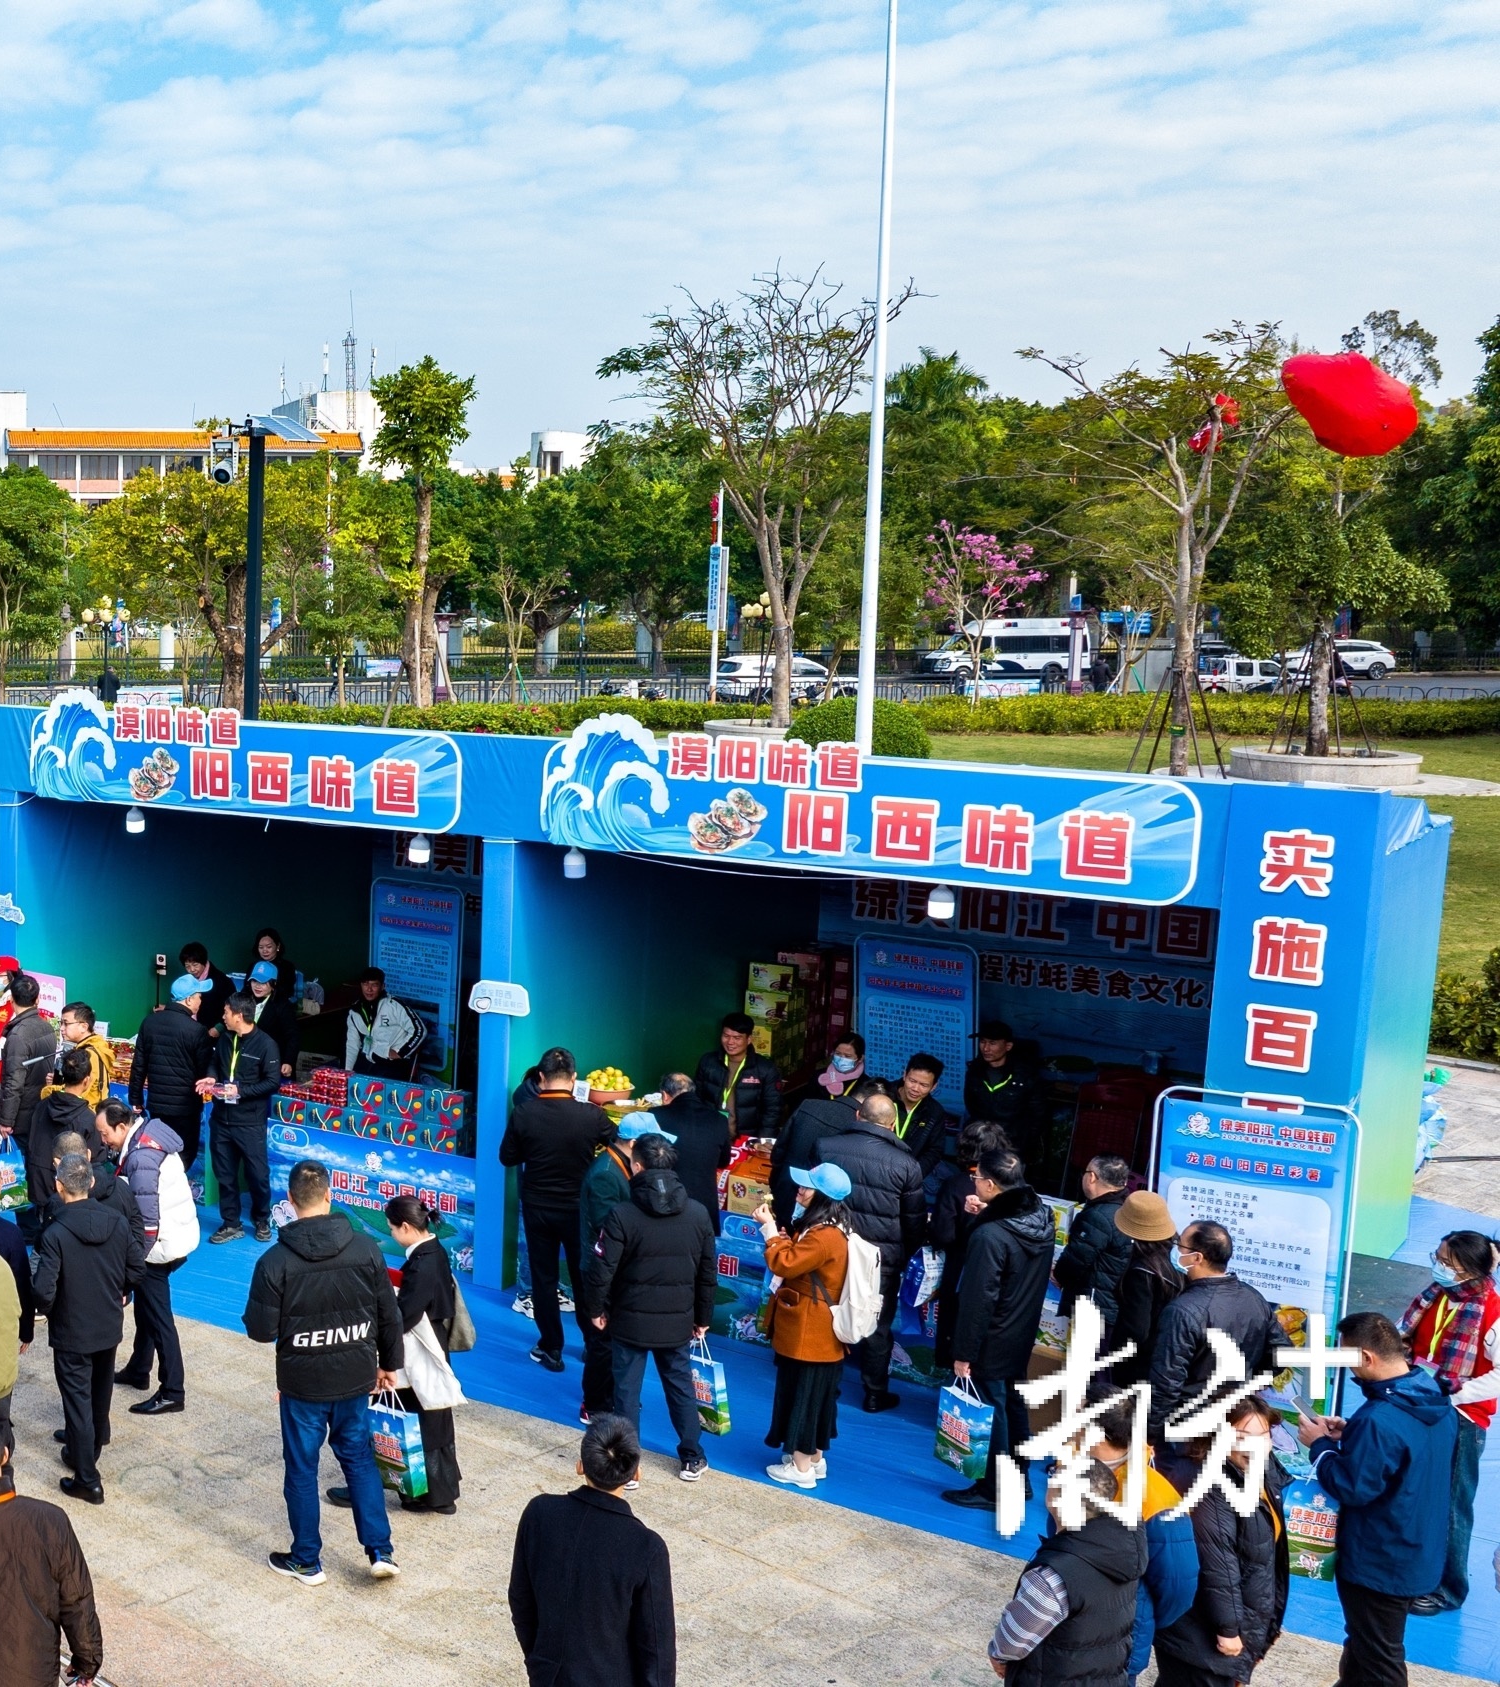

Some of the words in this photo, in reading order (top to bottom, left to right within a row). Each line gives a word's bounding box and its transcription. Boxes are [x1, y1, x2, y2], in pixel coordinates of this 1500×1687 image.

[115, 706, 239, 746] 漠阳味道
[669, 736, 861, 789] 漠阳味道
[192, 750, 419, 815] 阳西味道
[785, 793, 1131, 882] 阳西味道
[977, 952, 1214, 1009] 程村蚝美食文化
[1247, 833, 1329, 1113] 实施百
[1220, 1118, 1274, 1138] 绿美阳江
[1279, 1127, 1336, 1146] 中国蚝都
[1186, 1151, 1322, 1182] 龙高山阳西五彩薯
[1231, 1253, 1302, 1272] 弱碱地富元素红薯
[292, 1320, 372, 1348] GEINW
[1288, 1521, 1337, 1539] 中国蚝都
[1291, 1507, 1338, 1526] 绿美阳江
